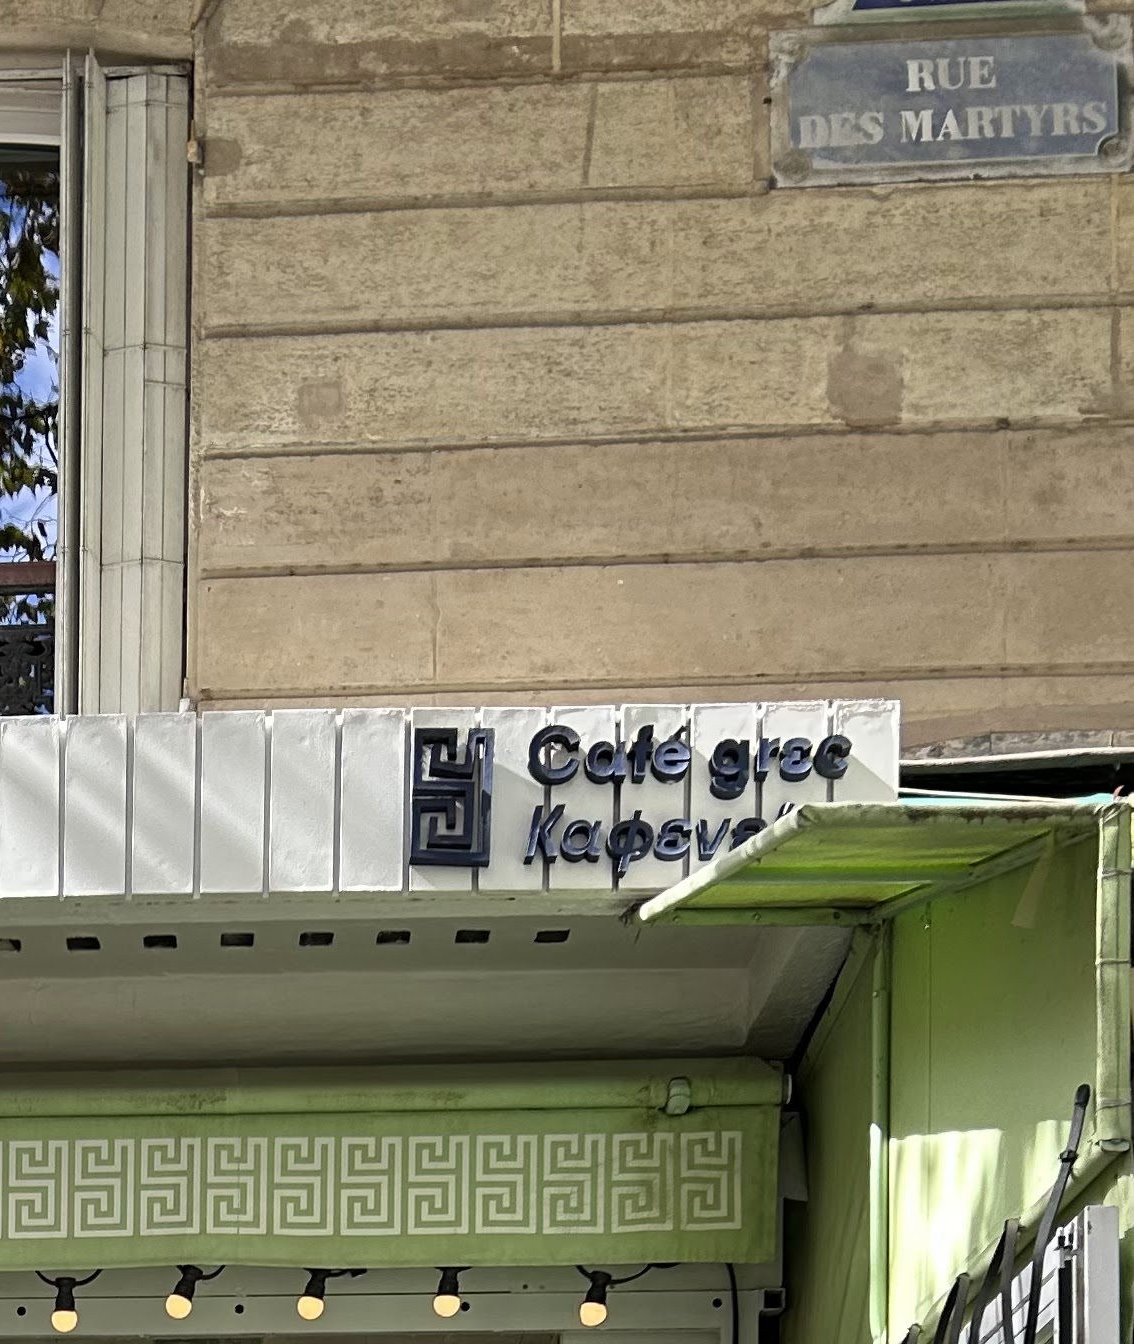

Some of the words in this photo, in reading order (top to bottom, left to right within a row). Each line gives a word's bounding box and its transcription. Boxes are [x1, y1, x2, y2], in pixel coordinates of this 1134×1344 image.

[905, 55, 998, 93] RUE
[797, 111, 885, 149] DES
[899, 101, 1108, 143] MARTYRS
[527, 723, 692, 785] Café
